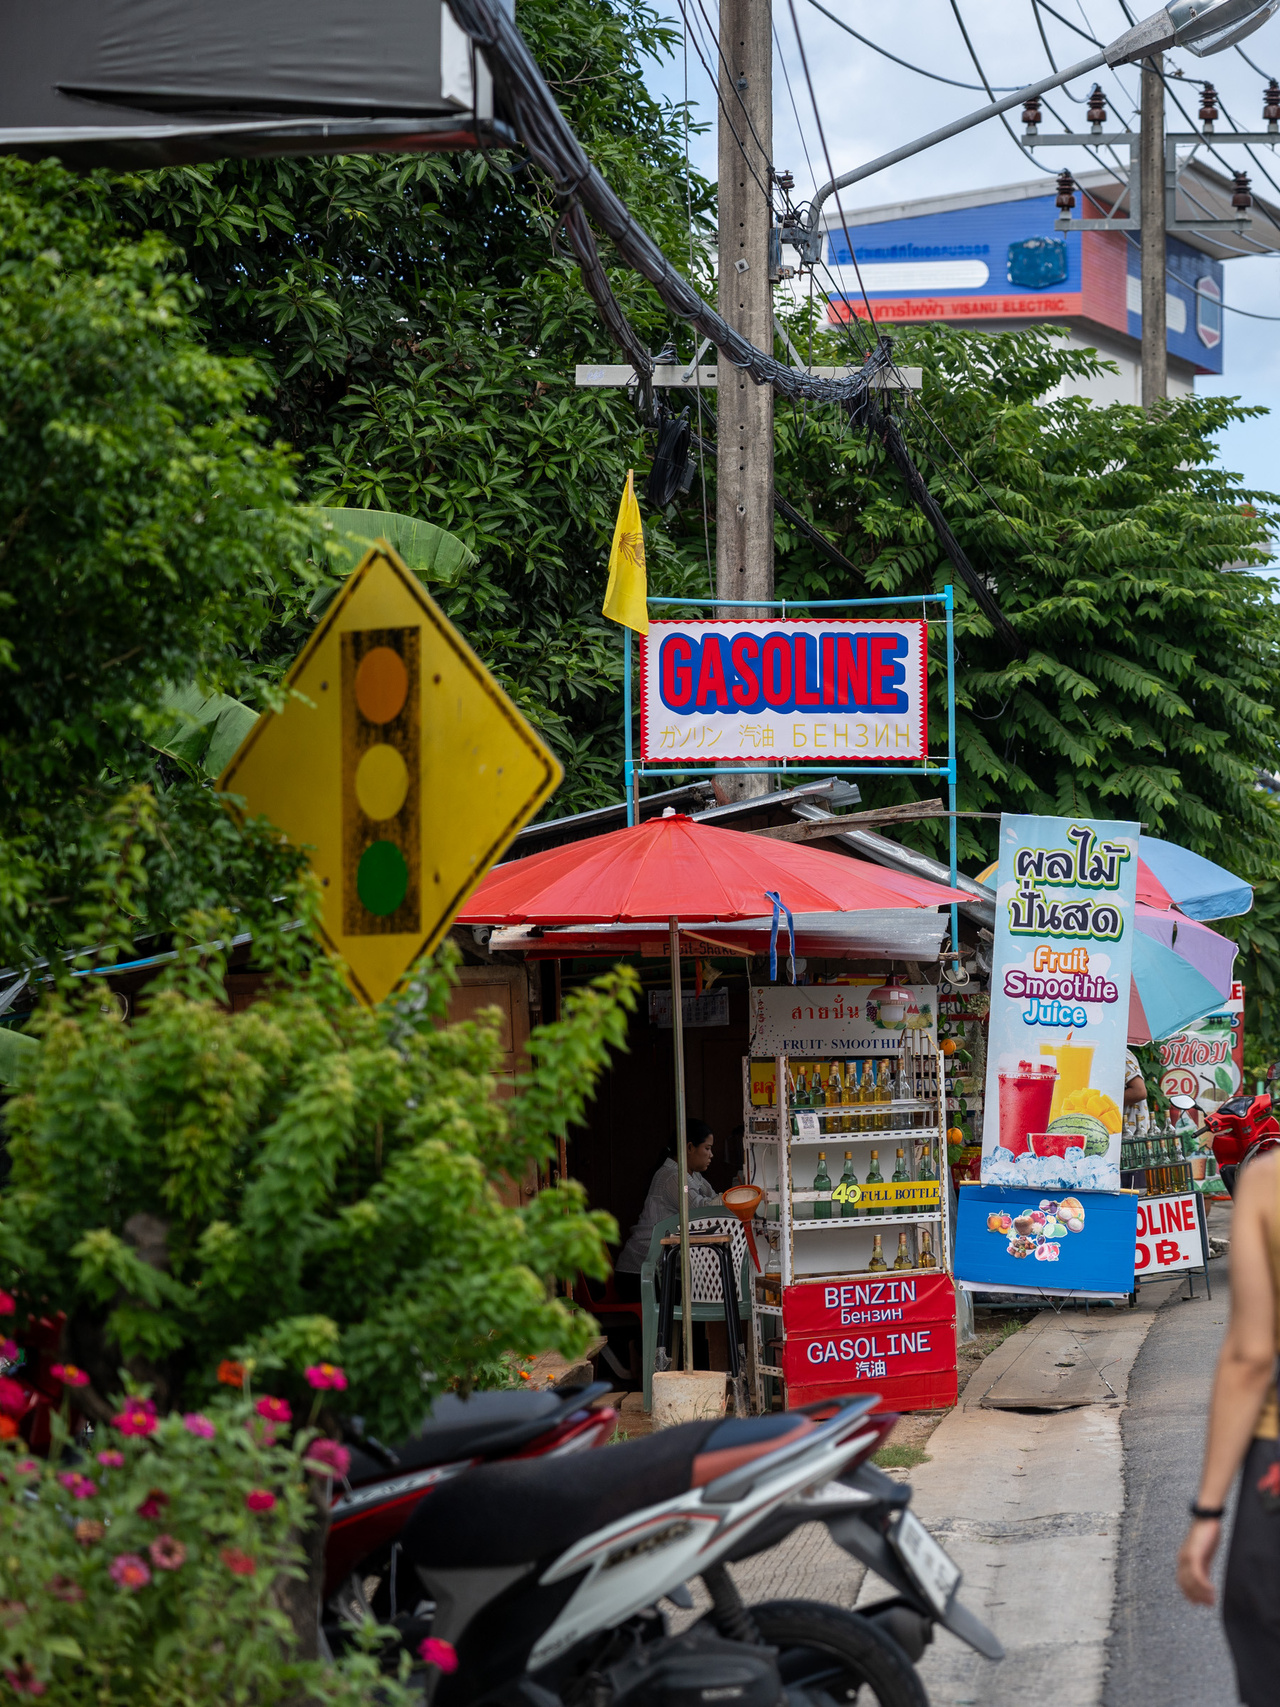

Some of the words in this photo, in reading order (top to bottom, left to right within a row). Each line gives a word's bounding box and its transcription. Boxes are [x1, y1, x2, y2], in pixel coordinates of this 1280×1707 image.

[951, 301, 1000, 315] VISANU
[661, 634, 904, 711] GASOLINE
[739, 724, 775, 748] 汽油
[793, 723, 910, 748] БЕНЗИН
[1017, 828, 1126, 882] ผลไม้
[1010, 881, 1120, 935] ปั่นสด
[1035, 947, 1087, 972] Fruit
[1005, 971, 1117, 1000] Smoothie
[791, 994, 860, 1020] สายปั่น
[1025, 999, 1086, 1025] Juice
[783, 1039, 824, 1050] FRUIT
[1165, 1077, 1194, 1096] 20
[832, 1183, 861, 1204] 40
[861, 1190, 892, 1202] FULL
[895, 1187, 940, 1200] BOTTLE
[1136, 1199, 1196, 1237] OLINE
[824, 1280, 917, 1309] BENZIN
[840, 1307, 903, 1325] Бензин
[807, 1330, 932, 1364] GASOLINE
[855, 1359, 887, 1379] 汽油
